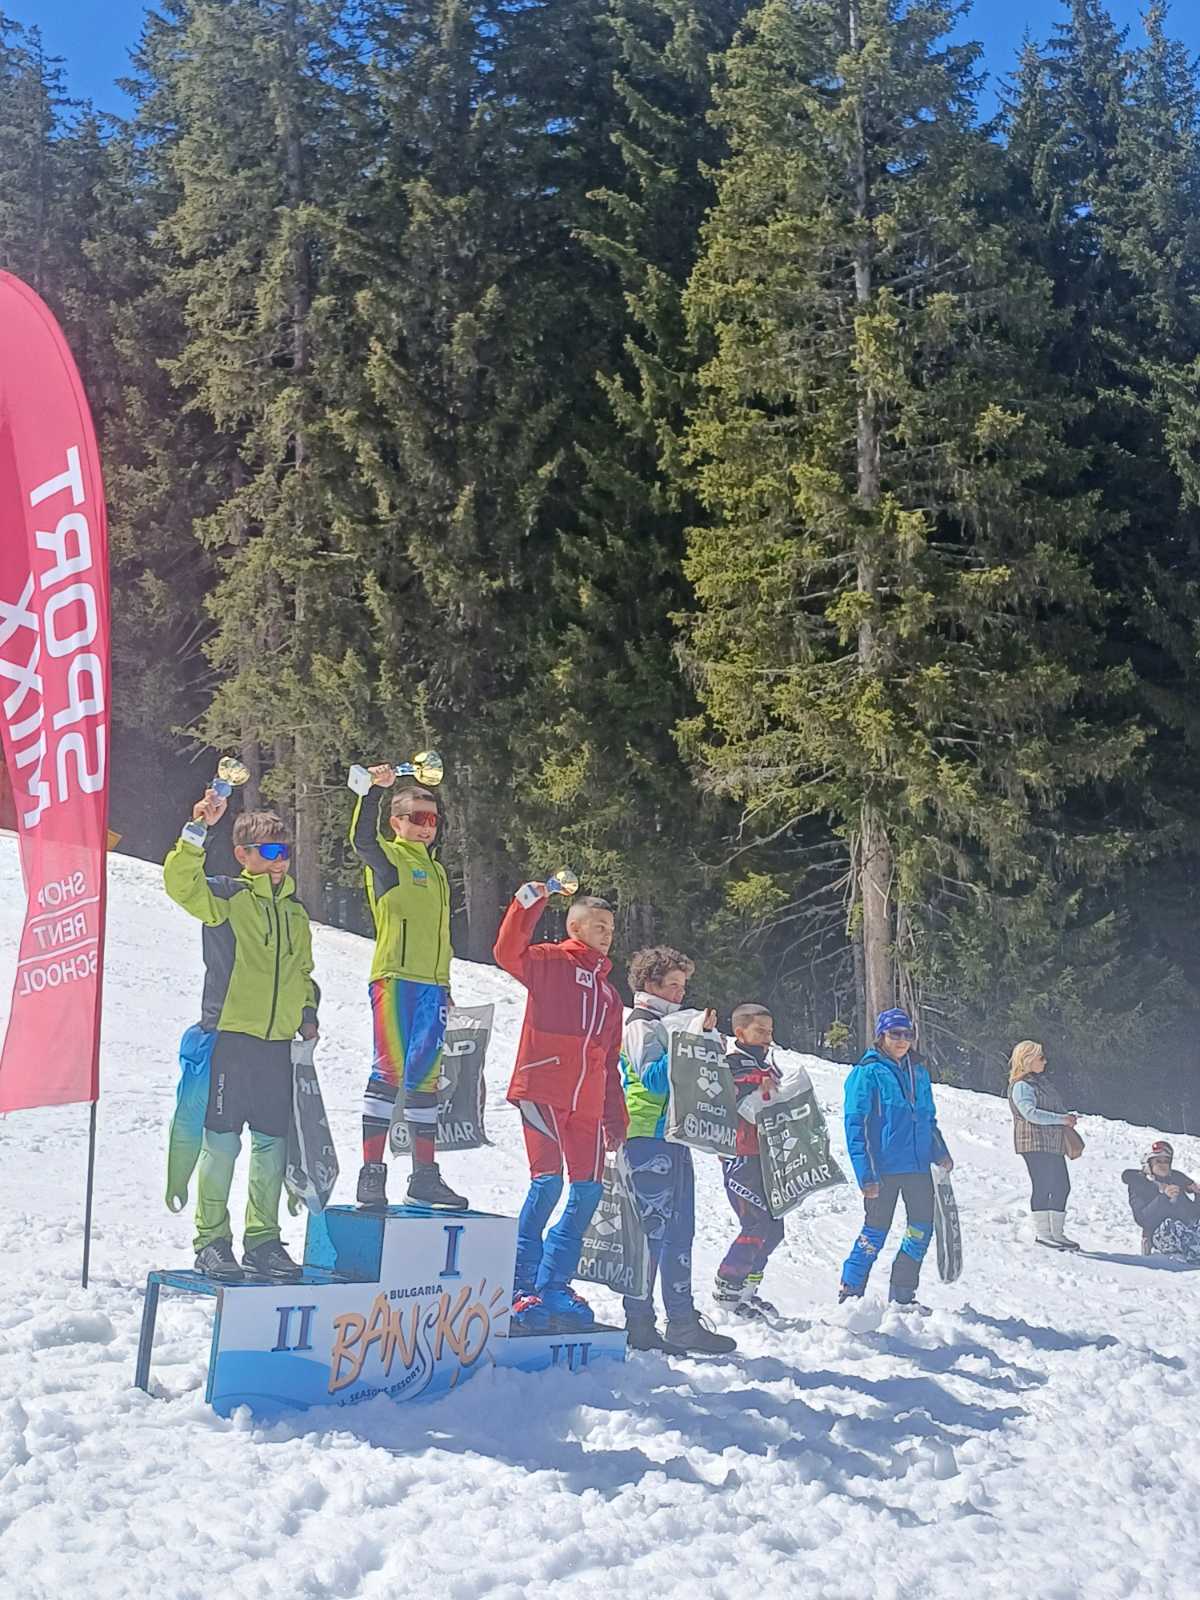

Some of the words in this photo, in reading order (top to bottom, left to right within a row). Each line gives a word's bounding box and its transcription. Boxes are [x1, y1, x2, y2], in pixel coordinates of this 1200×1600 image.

[763, 1103, 811, 1131] EAD
[729, 1180, 766, 1210] REPSO
[577, 1256, 635, 1289] COLMAR
[389, 1284, 443, 1300] BULGARIA
[328, 1285, 490, 1395] BANSKO
[390, 1364, 421, 1393] RESORT
